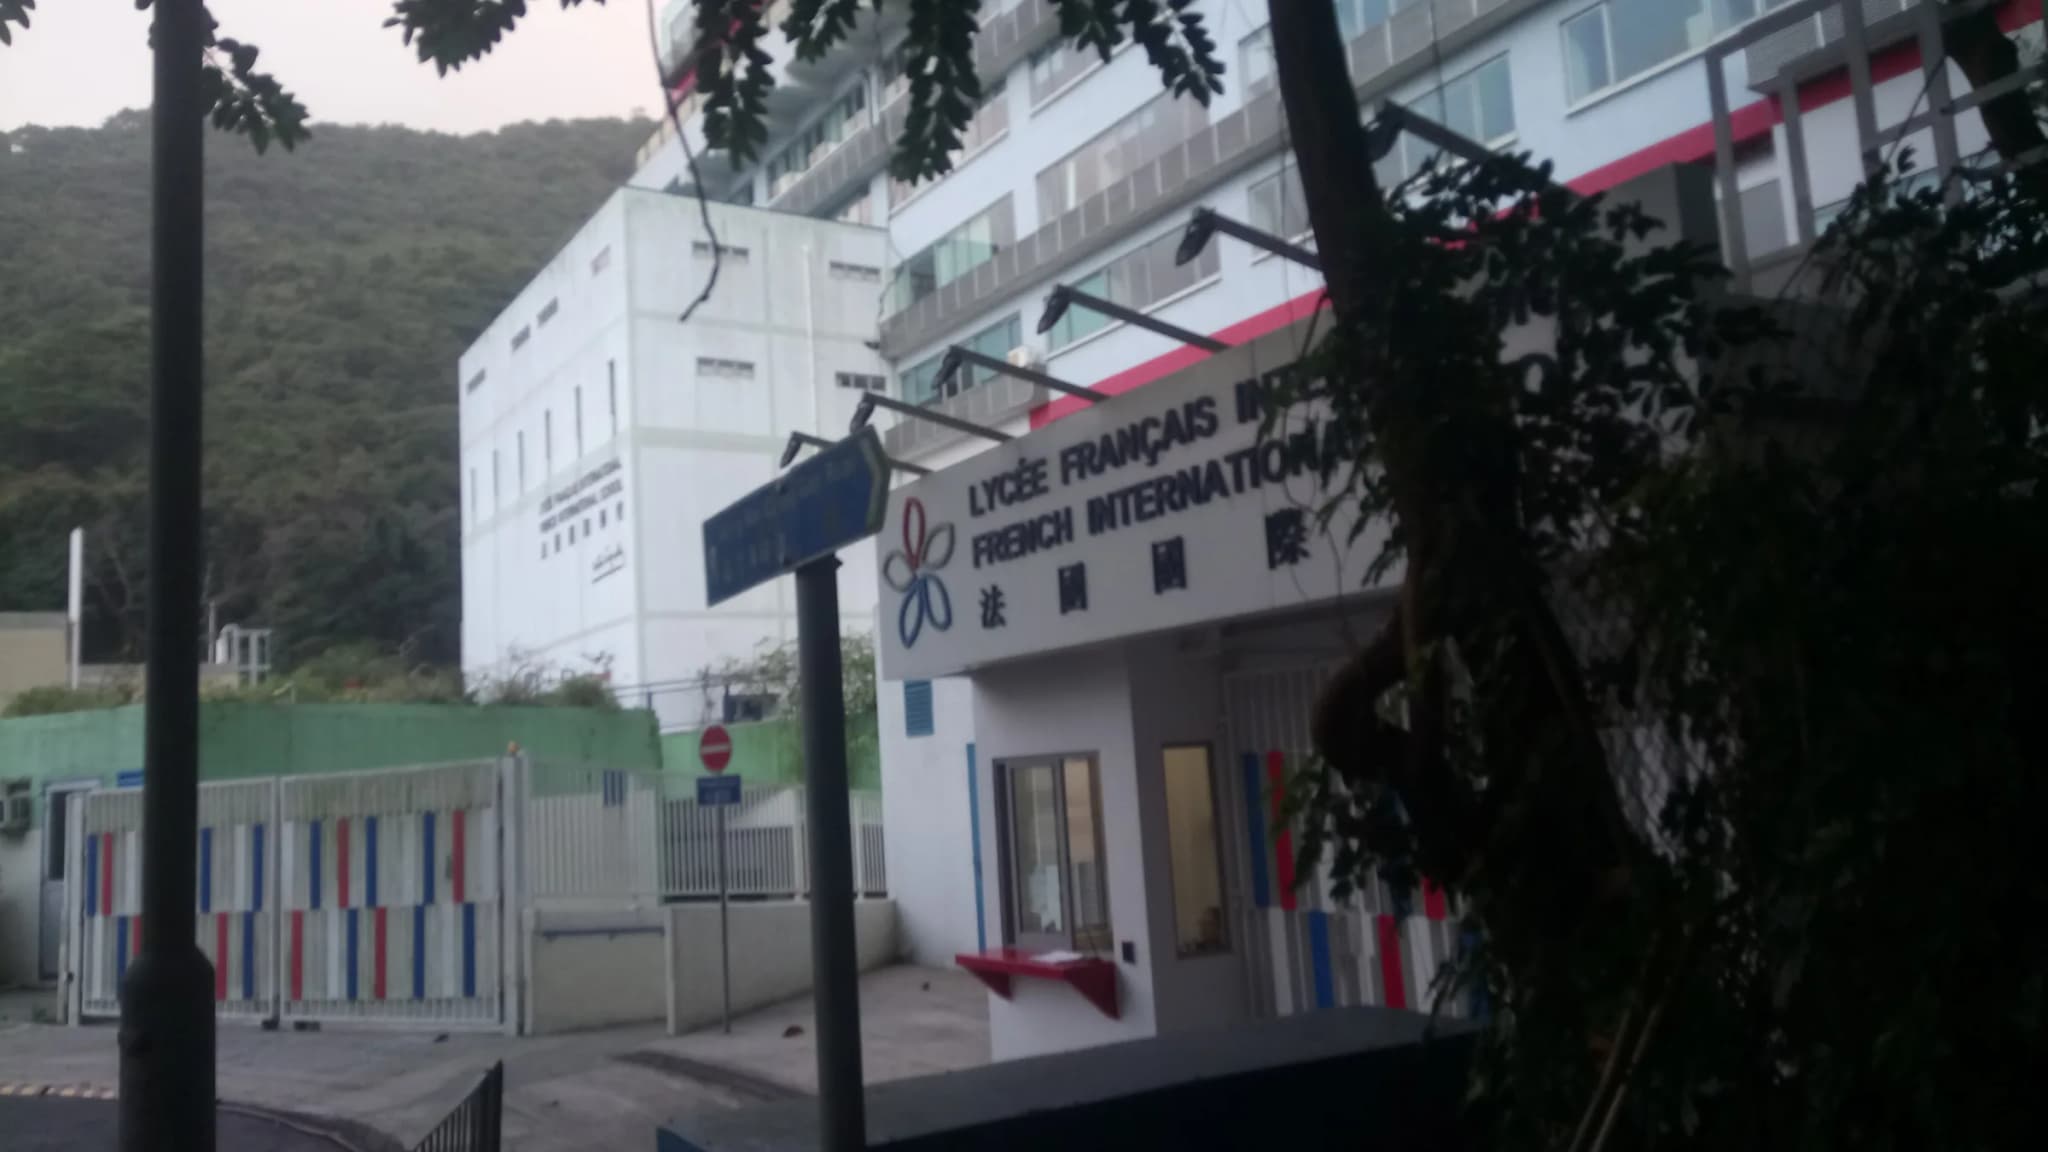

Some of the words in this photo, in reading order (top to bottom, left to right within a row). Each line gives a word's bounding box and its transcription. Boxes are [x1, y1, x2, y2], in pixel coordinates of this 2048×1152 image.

[969, 457, 1049, 518] LYCÉE
[1060, 395, 1219, 486] FRANÇAIS
[972, 506, 1074, 569] FRENCH
